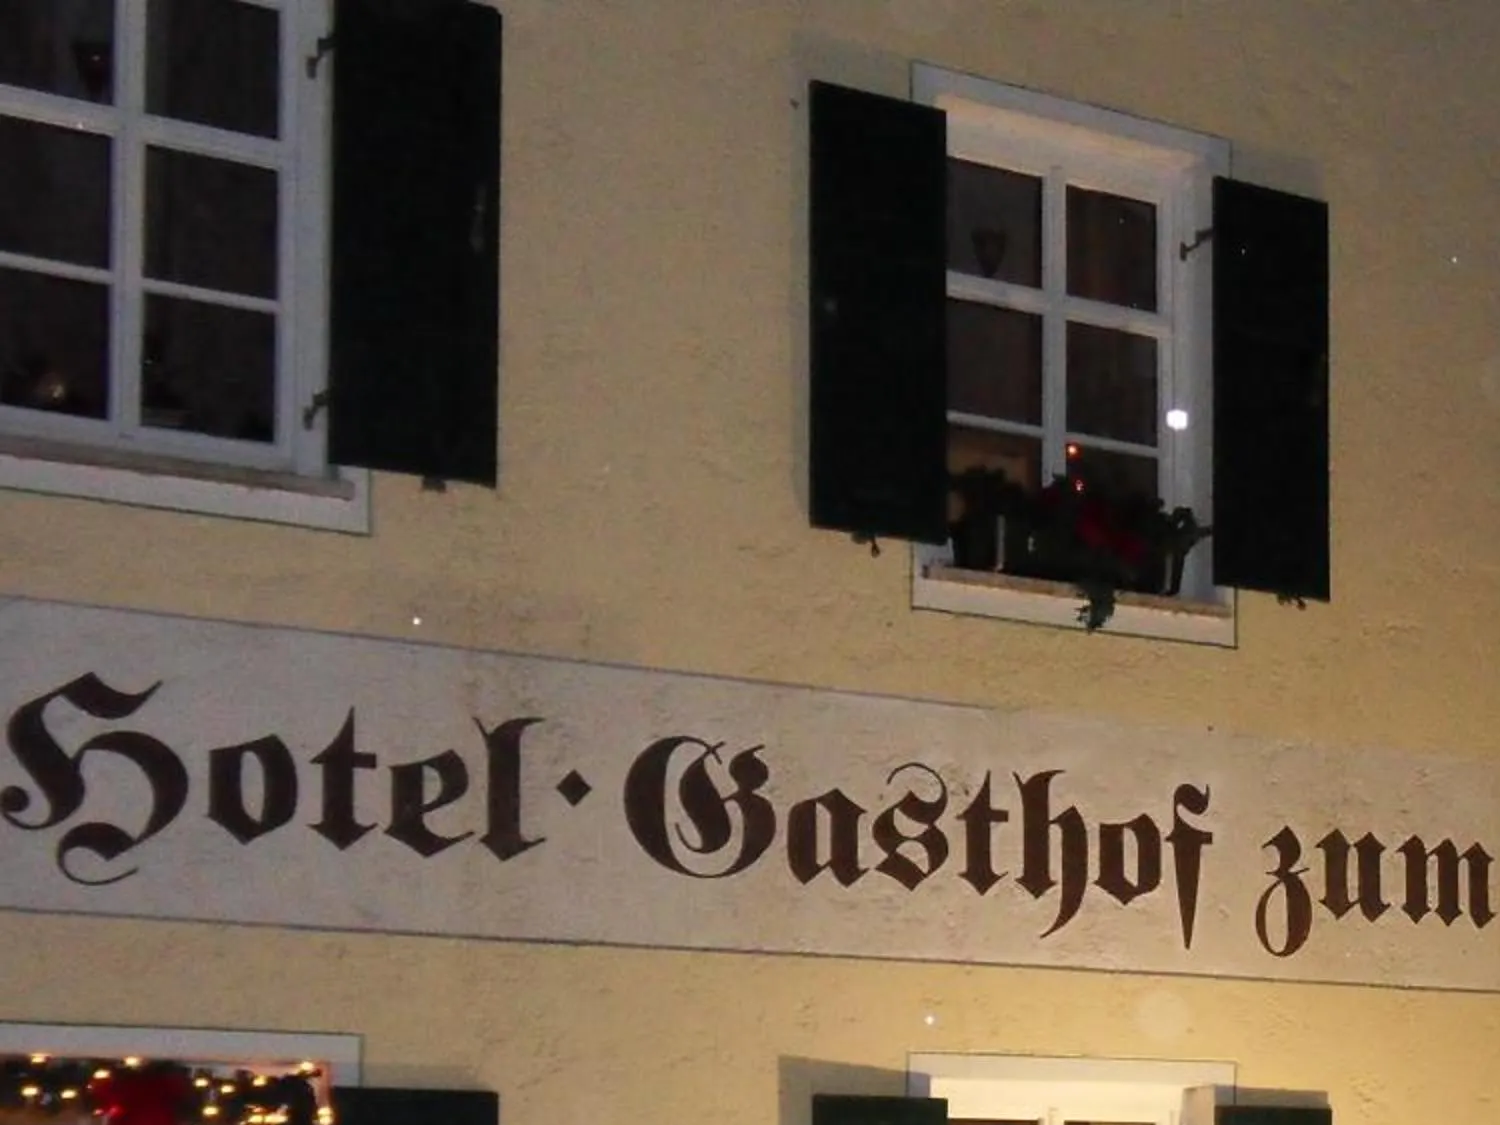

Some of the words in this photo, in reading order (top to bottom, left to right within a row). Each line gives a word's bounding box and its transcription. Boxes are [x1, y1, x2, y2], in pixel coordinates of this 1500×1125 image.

[0, 672, 545, 886] Hotel
[624, 735, 1213, 951] Gasthof
[1255, 824, 1498, 957] zum
